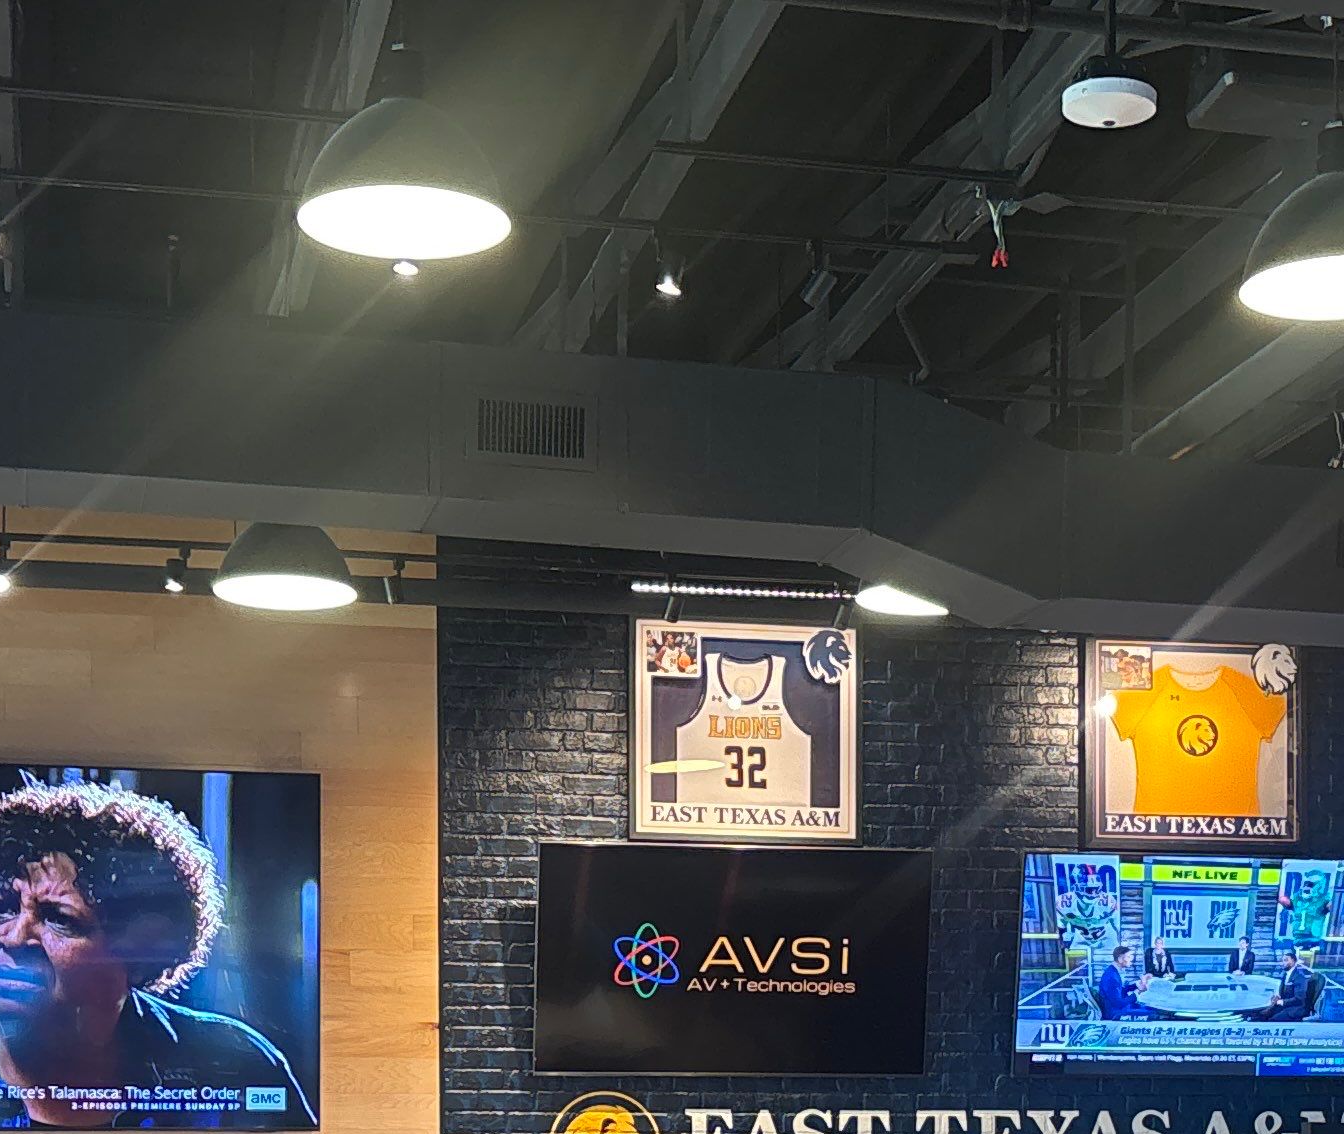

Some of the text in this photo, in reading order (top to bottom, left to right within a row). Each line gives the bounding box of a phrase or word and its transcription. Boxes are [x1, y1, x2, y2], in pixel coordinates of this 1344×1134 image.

[708, 715, 782, 740] LIONS
[724, 745, 768, 789] 32
[650, 805, 841, 828] EAST TEXAS A&M
[1105, 815, 1288, 836] EAST TEXAS A&M
[1172, 869, 1238, 880] NFL LIVE
[699, 937, 850, 975] AVSi
[687, 978, 856, 995] AV + Technologies
[1120, 1026, 1152, 1035] Giants
[1177, 1027, 1188, 1035] at
[1189, 1027, 1221, 1036] Eagles
[1281, 1028, 1295, 1036] ET
[8, 1086, 46, 1099] Rice's
[48, 1086, 122, 1099] Talamasca:
[124, 1086, 151, 1099] The
[154, 1086, 197, 1099] Secret
[201, 1086, 240, 1100] Order
[130, 1102, 181, 1110] PREMIERE
[185, 1102, 224, 1111] SUNDAY
